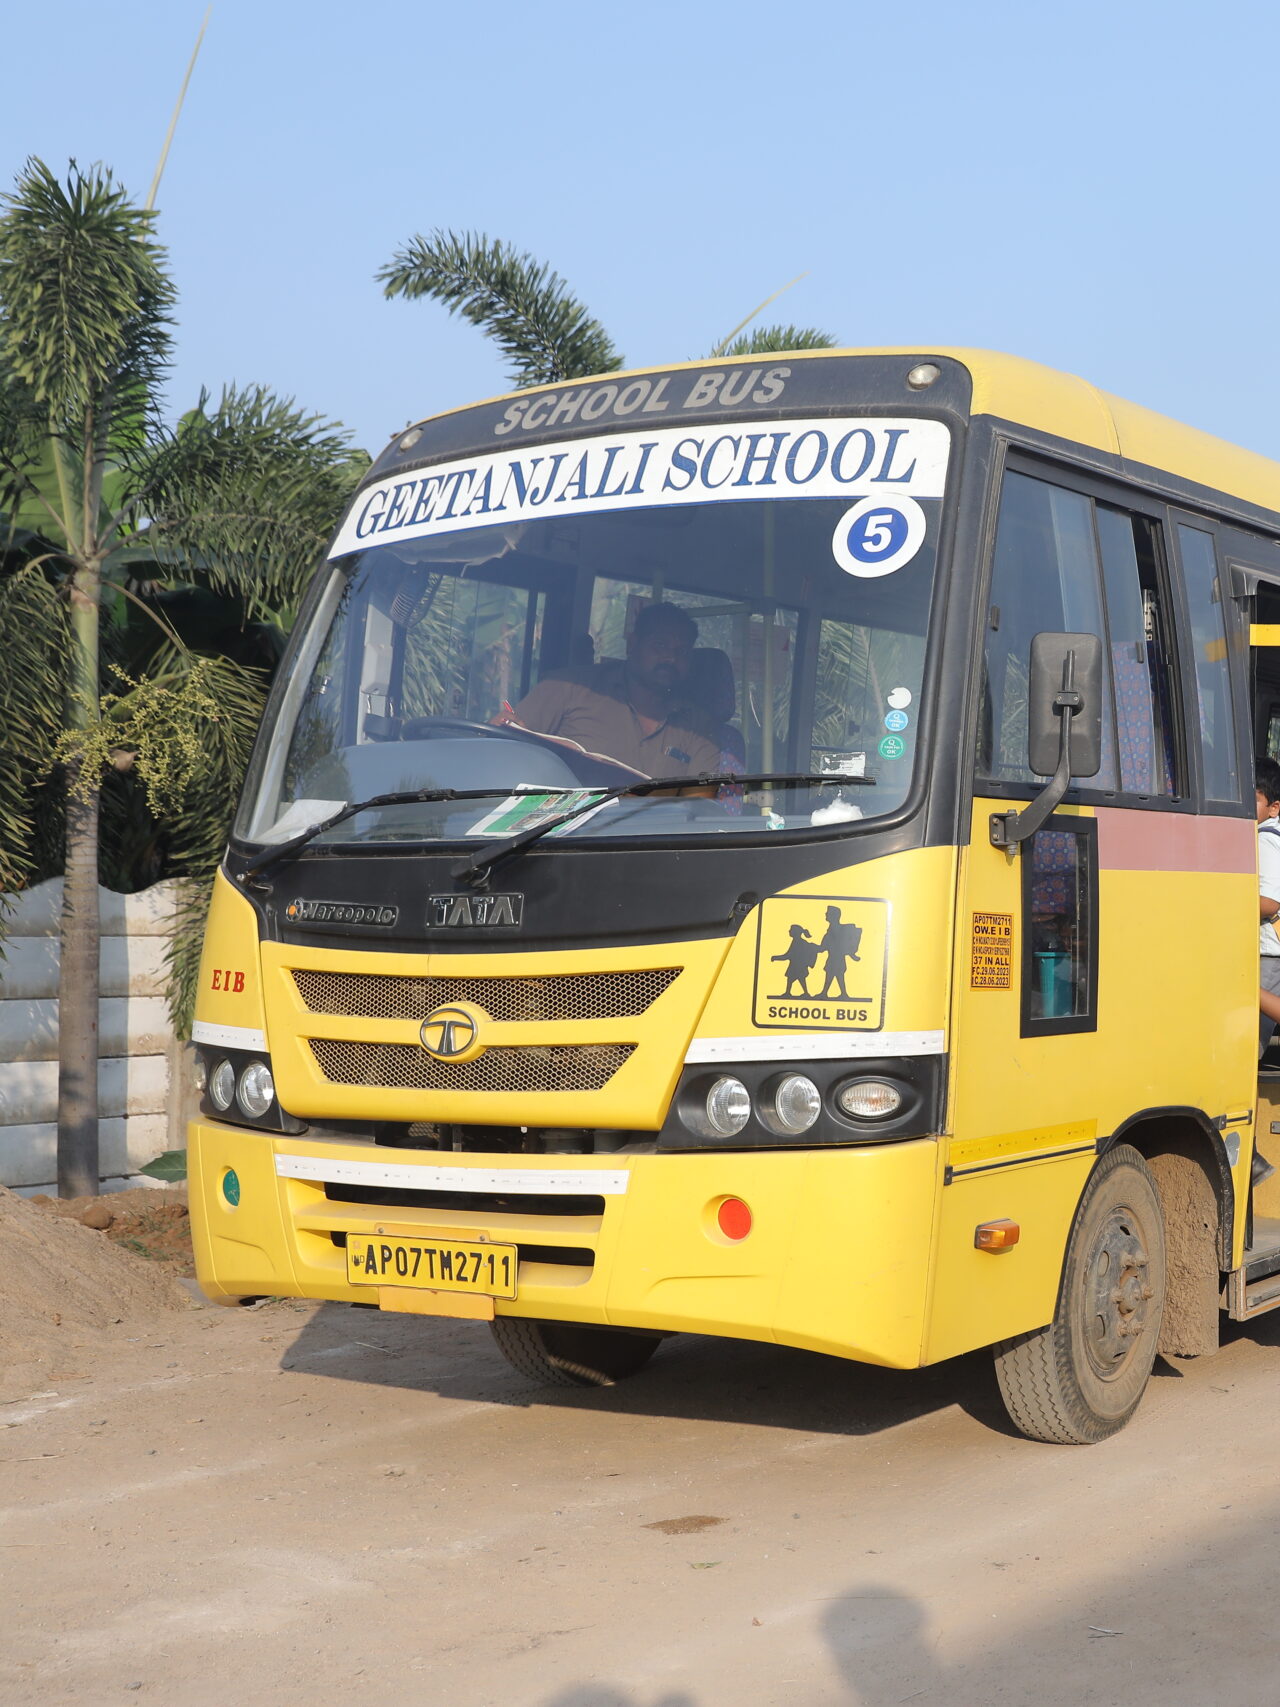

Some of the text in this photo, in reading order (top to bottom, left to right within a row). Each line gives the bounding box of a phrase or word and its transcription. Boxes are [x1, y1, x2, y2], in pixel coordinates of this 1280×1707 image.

[494, 367, 791, 435] SCHOOL BUS
[356, 428, 918, 539] GEETANJALI SCHOOL
[862, 513, 893, 553] 5
[432, 896, 515, 926] TATA
[974, 915, 1011, 926] AP07TM2711
[973, 956, 1009, 966] 37 IN ALL
[768, 1006, 868, 1022] SCHOOL BUS
[365, 1244, 510, 1287] AP07TM2711
